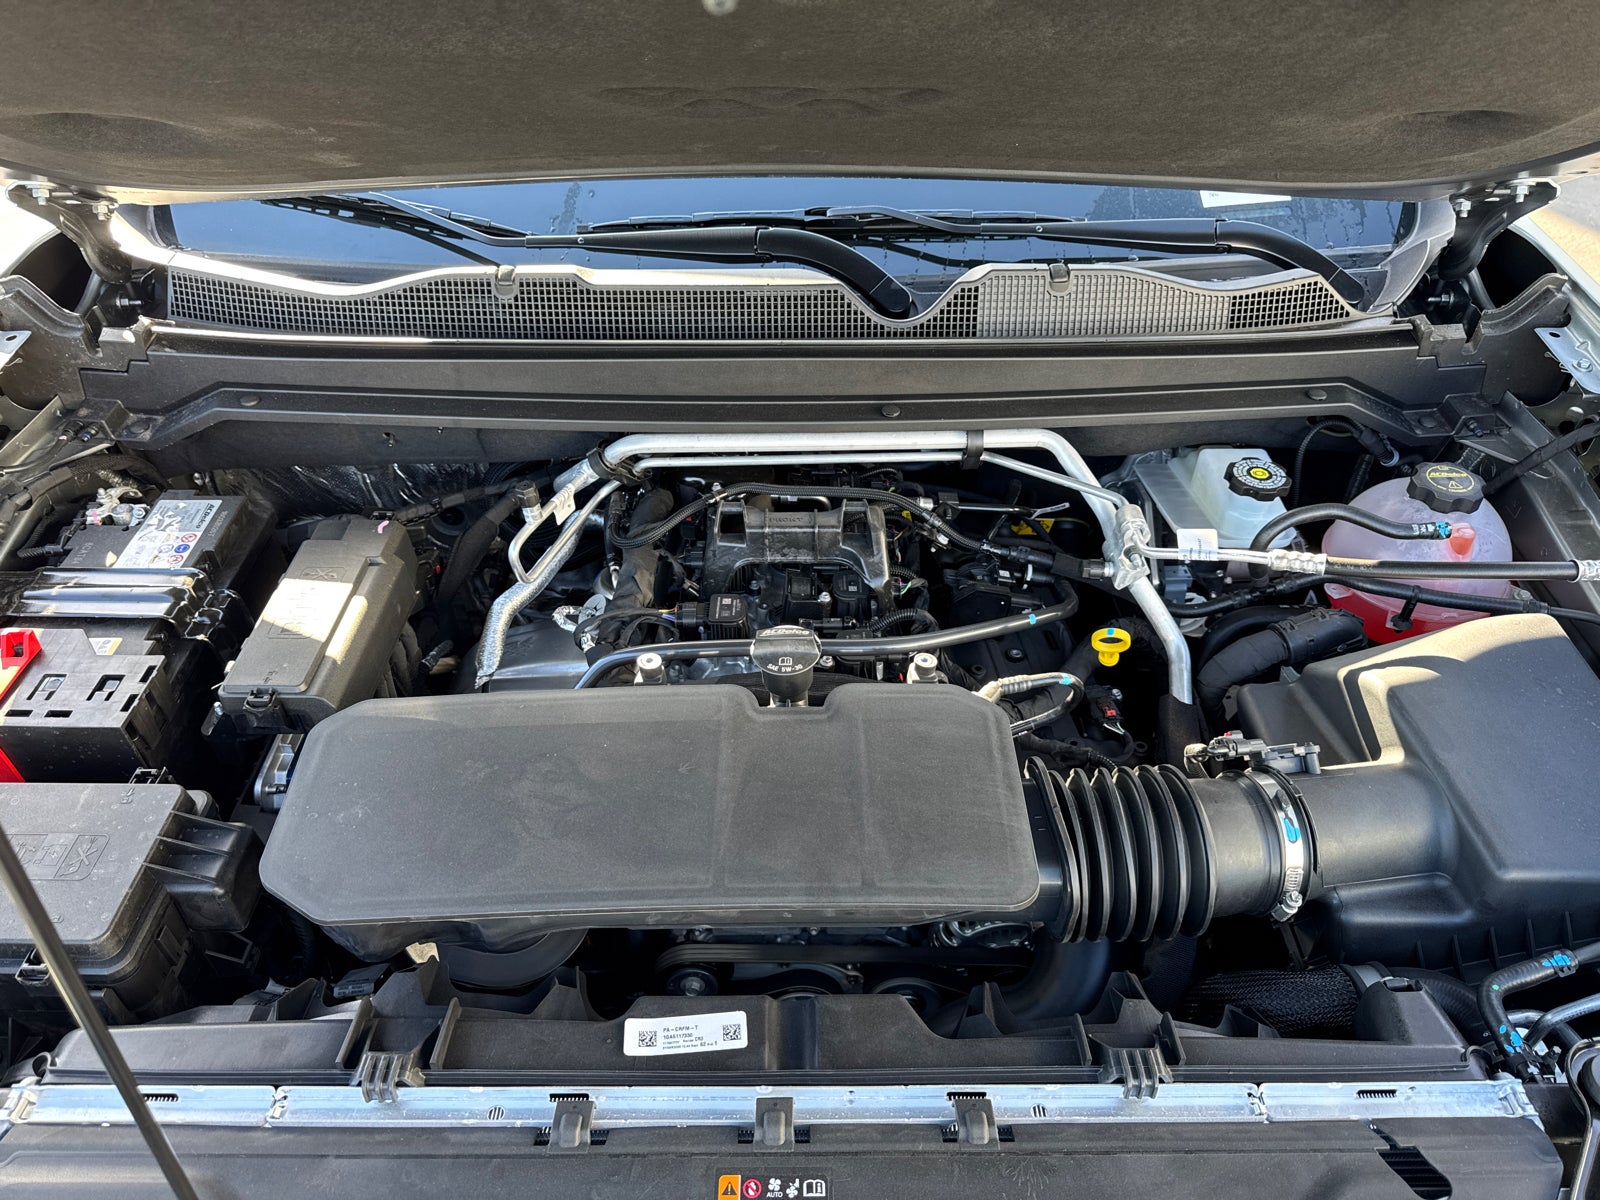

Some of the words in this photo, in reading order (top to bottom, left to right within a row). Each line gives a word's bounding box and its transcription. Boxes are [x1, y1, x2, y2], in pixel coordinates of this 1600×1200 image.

[196, 503, 215, 529] ACDelco
[760, 629, 810, 637] ACDelco
[766, 663, 779, 672] SAE
